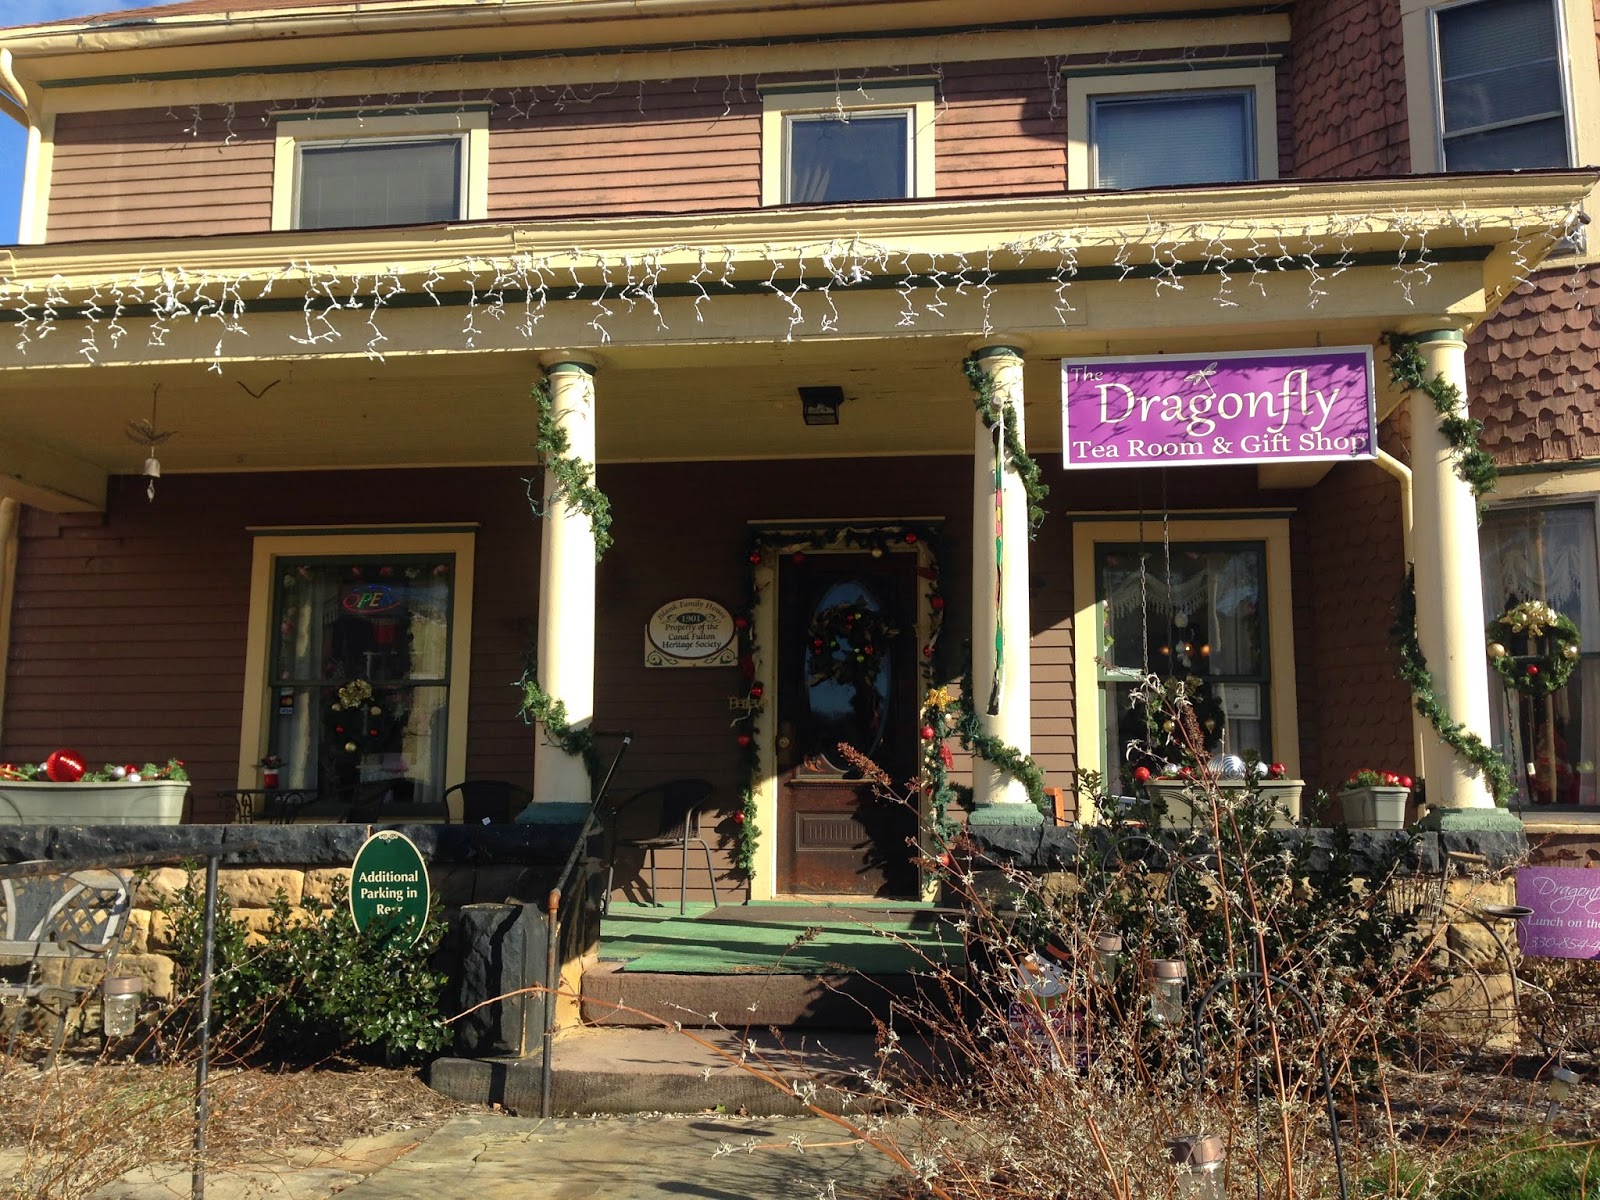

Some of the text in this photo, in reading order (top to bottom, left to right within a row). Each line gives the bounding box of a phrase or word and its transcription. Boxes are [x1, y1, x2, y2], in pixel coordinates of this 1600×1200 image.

[1070, 366, 1103, 382] The
[1094, 369, 1340, 437] Dragonfly
[1072, 431, 1367, 459] Tea Room & Gift Shop
[680, 599, 705, 609] Family
[705, 602, 728, 619] House
[665, 624, 697, 633] Property
[698, 624, 705, 633] of
[668, 633, 690, 641] Canal
[662, 641, 722, 651] Heritage Society
[359, 870, 419, 882] Additional
[360, 886, 418, 902] Parking in
[376, 904, 403, 915] Rer
[1527, 916, 1563, 927] Lunch
[1567, 918, 1581, 928] on
